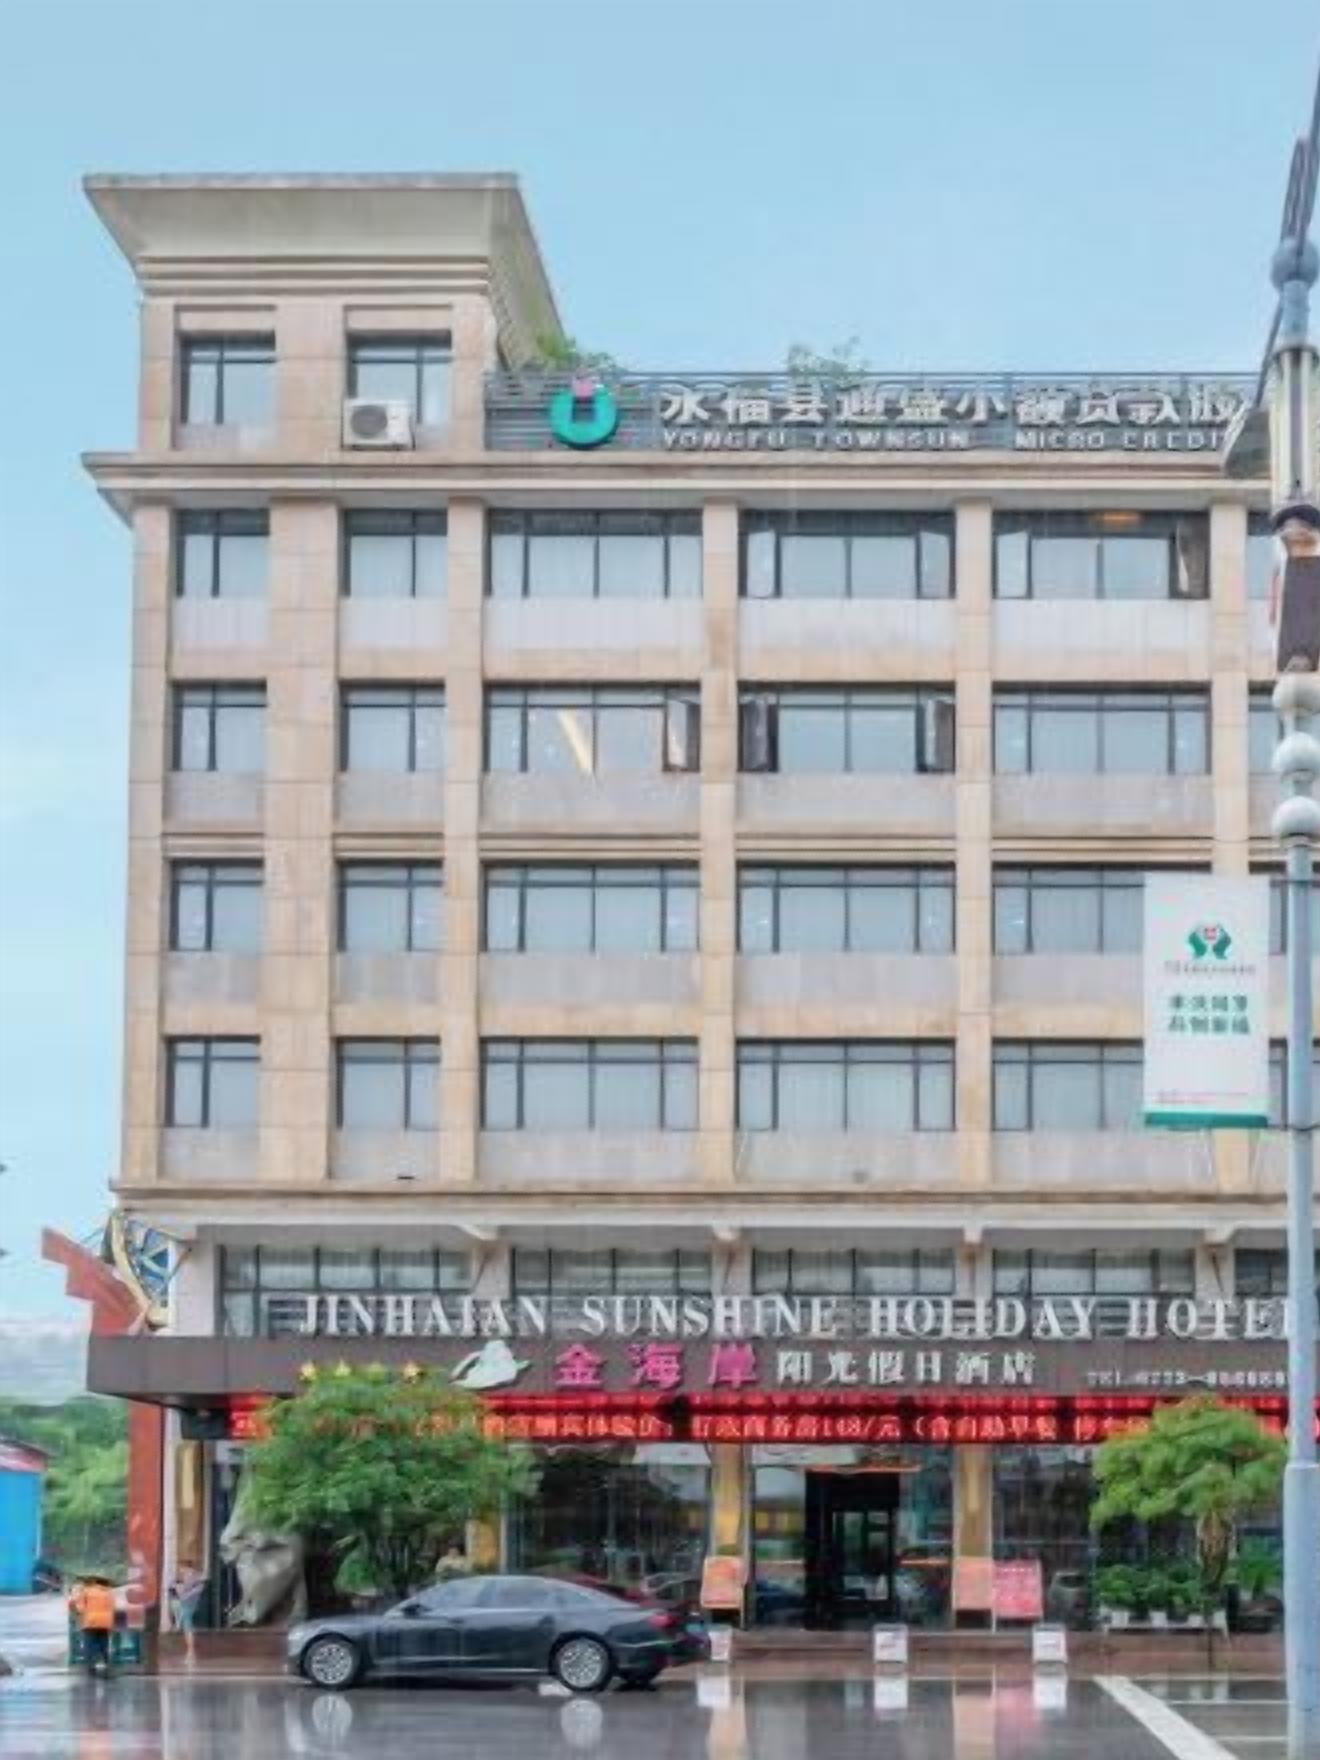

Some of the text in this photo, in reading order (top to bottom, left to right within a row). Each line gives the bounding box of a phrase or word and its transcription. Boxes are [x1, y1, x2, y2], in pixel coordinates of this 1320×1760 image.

[1123, 430, 1224, 449] CREDI
[580, 1295, 838, 1337] SUNSHINE
[868, 1297, 1098, 1340] HOLIDAY
[554, 1343, 1036, 1389] 金海岸 阳光假日酒店
